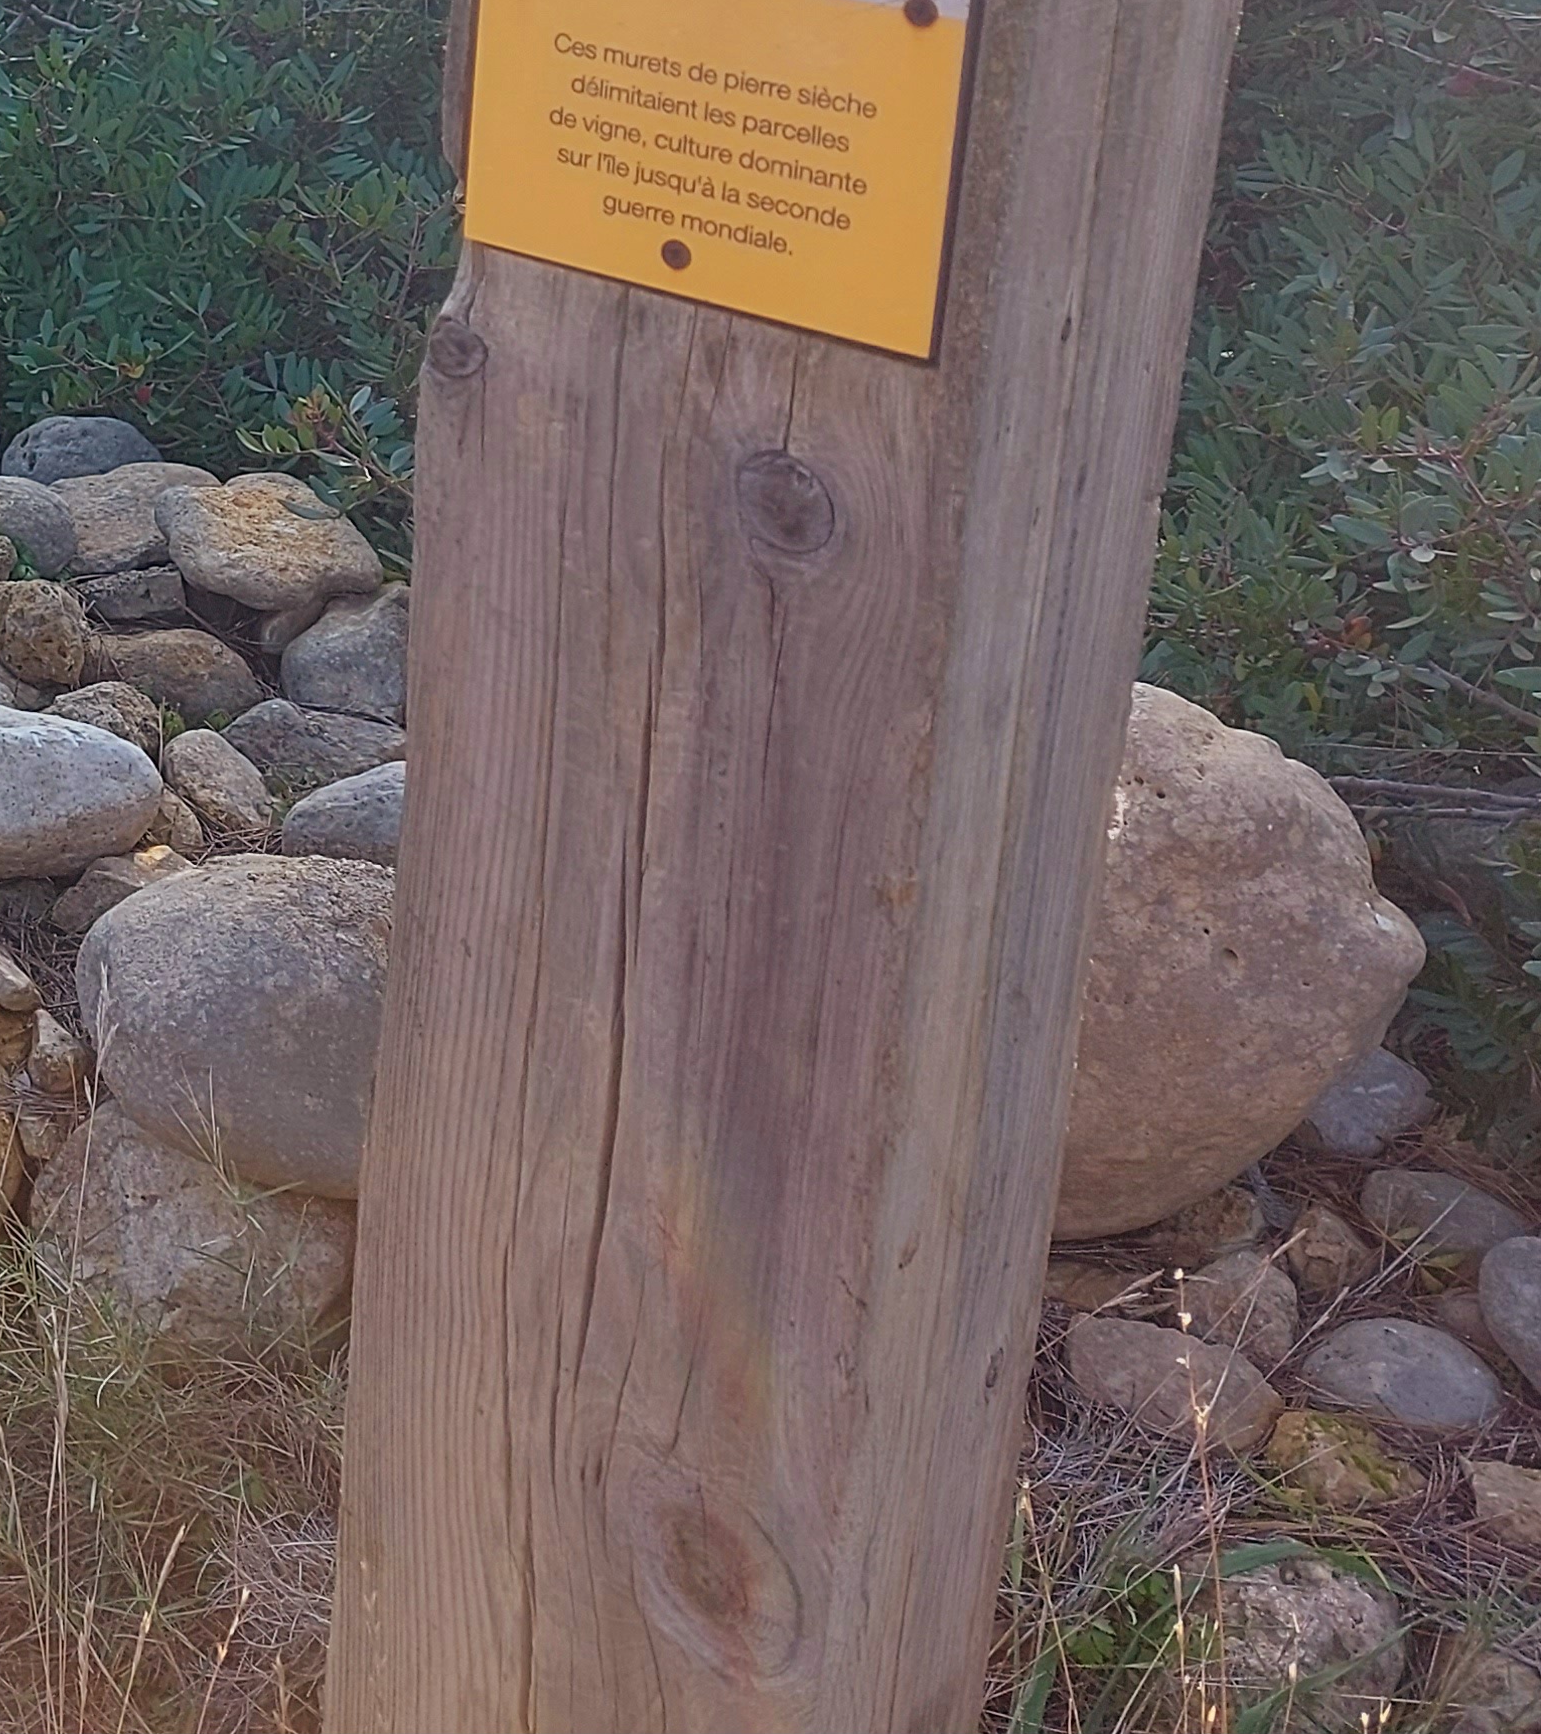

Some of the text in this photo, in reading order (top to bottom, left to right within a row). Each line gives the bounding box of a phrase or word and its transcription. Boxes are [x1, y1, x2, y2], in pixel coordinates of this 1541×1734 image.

[553, 32, 878, 119] Ces murets de pierre sièche
[571, 75, 850, 153] délimitaient les parcelles
[549, 106, 868, 195] de vigne, culture dominante
[557, 147, 852, 230] sur l'île jusqu'à la seconde
[602, 194, 793, 256] guerre mondiale.
